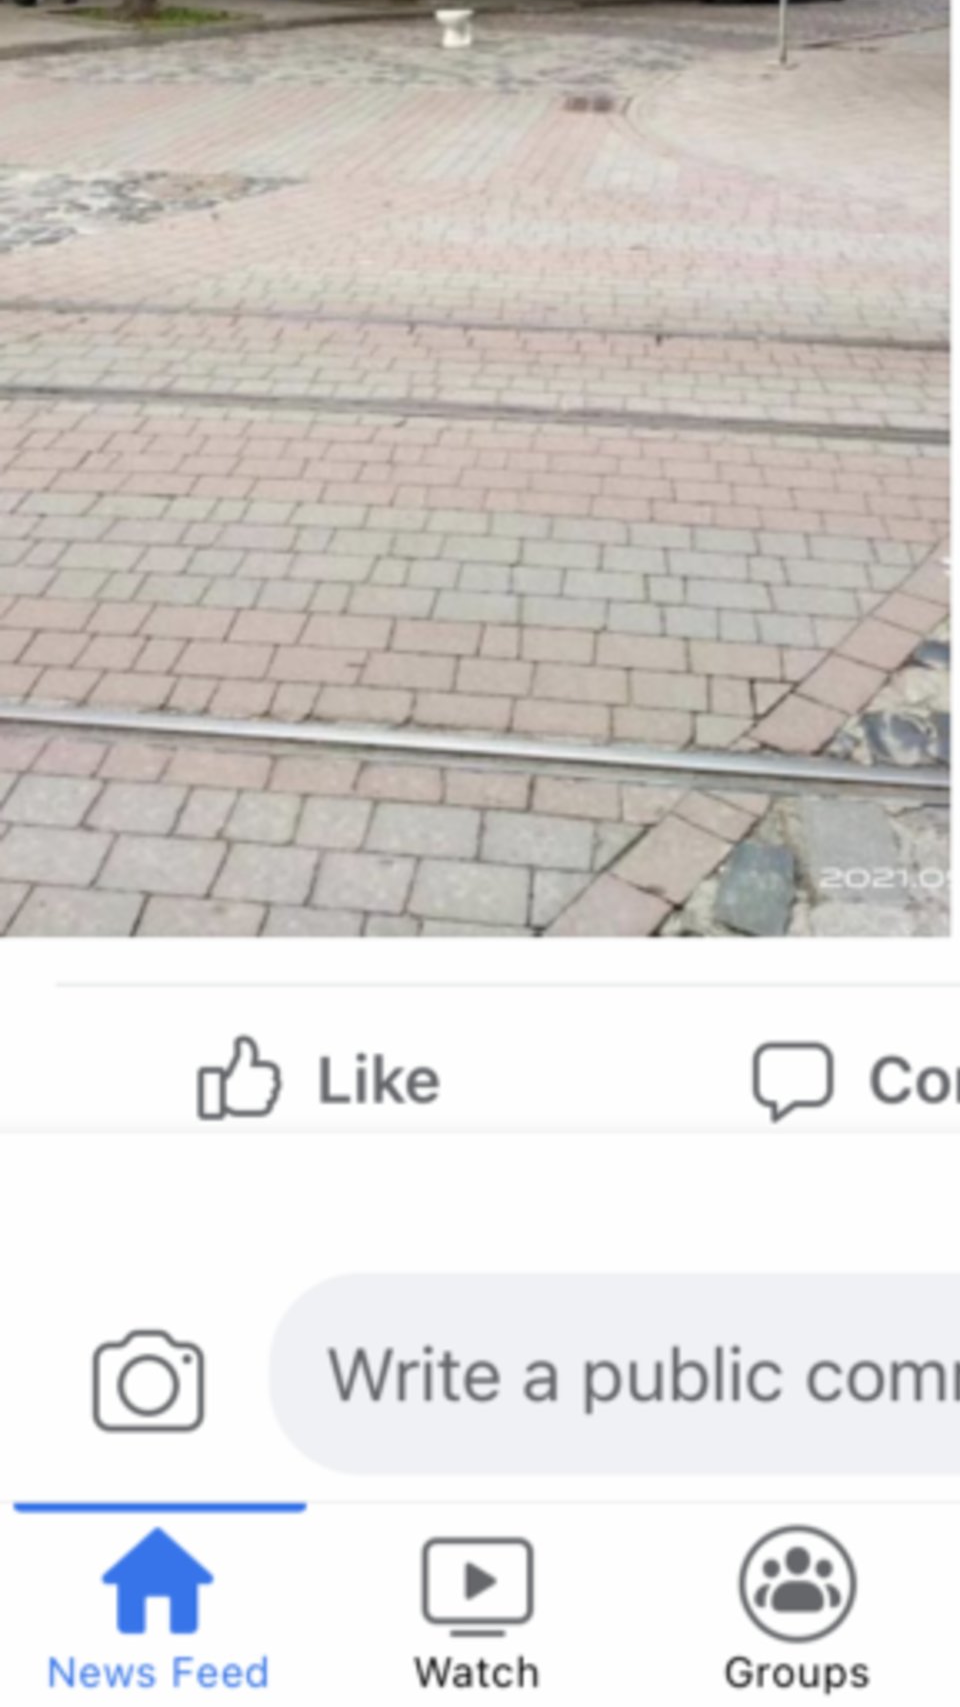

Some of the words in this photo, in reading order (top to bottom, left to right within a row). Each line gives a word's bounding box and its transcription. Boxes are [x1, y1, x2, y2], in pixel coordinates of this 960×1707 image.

[320, 1053, 440, 1104] Like
[328, 1345, 500, 1402] Write
[523, 1360, 557, 1403] a
[584, 1345, 782, 1415] public
[47, 1656, 157, 1689] News
[172, 1656, 269, 1689] Feed
[414, 1655, 538, 1688] Watch
[725, 1656, 870, 1697] Groups
